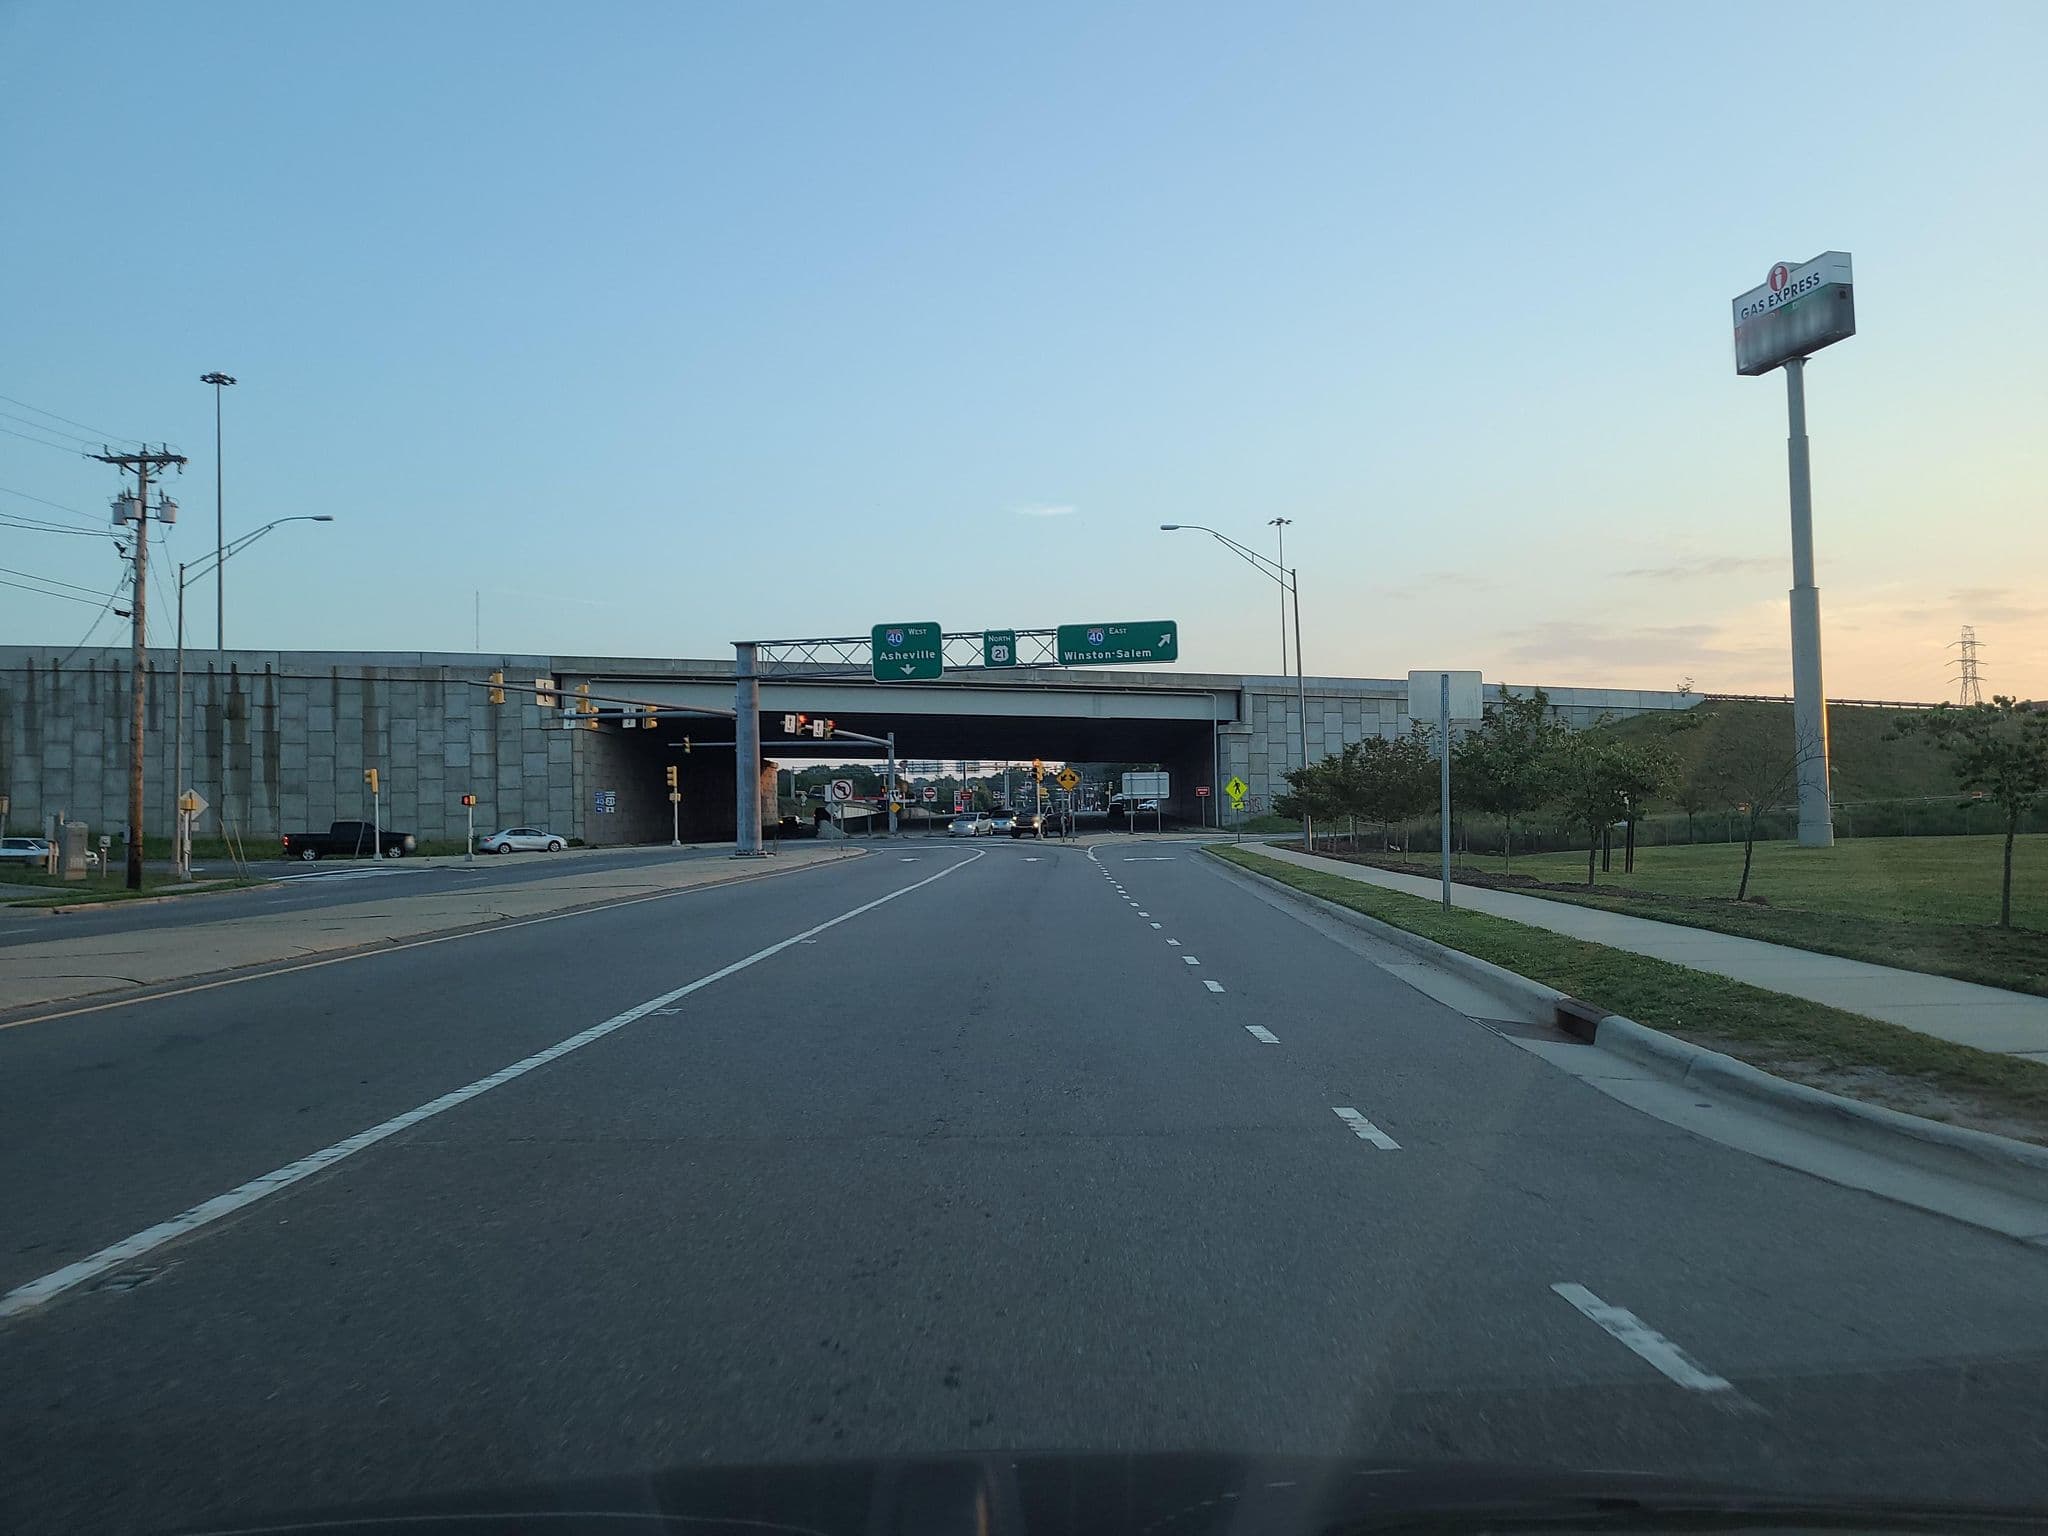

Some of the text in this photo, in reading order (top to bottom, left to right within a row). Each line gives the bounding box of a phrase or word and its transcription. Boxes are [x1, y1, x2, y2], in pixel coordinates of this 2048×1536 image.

[1740, 272, 1821, 320] GAS EXPRESS
[888, 633, 902, 643] 40
[1089, 627, 1127, 642] 40 EAST
[879, 650, 936, 661] Asheville
[994, 649, 1006, 659] 21
[1064, 649, 1152, 661] Winston-Salem
